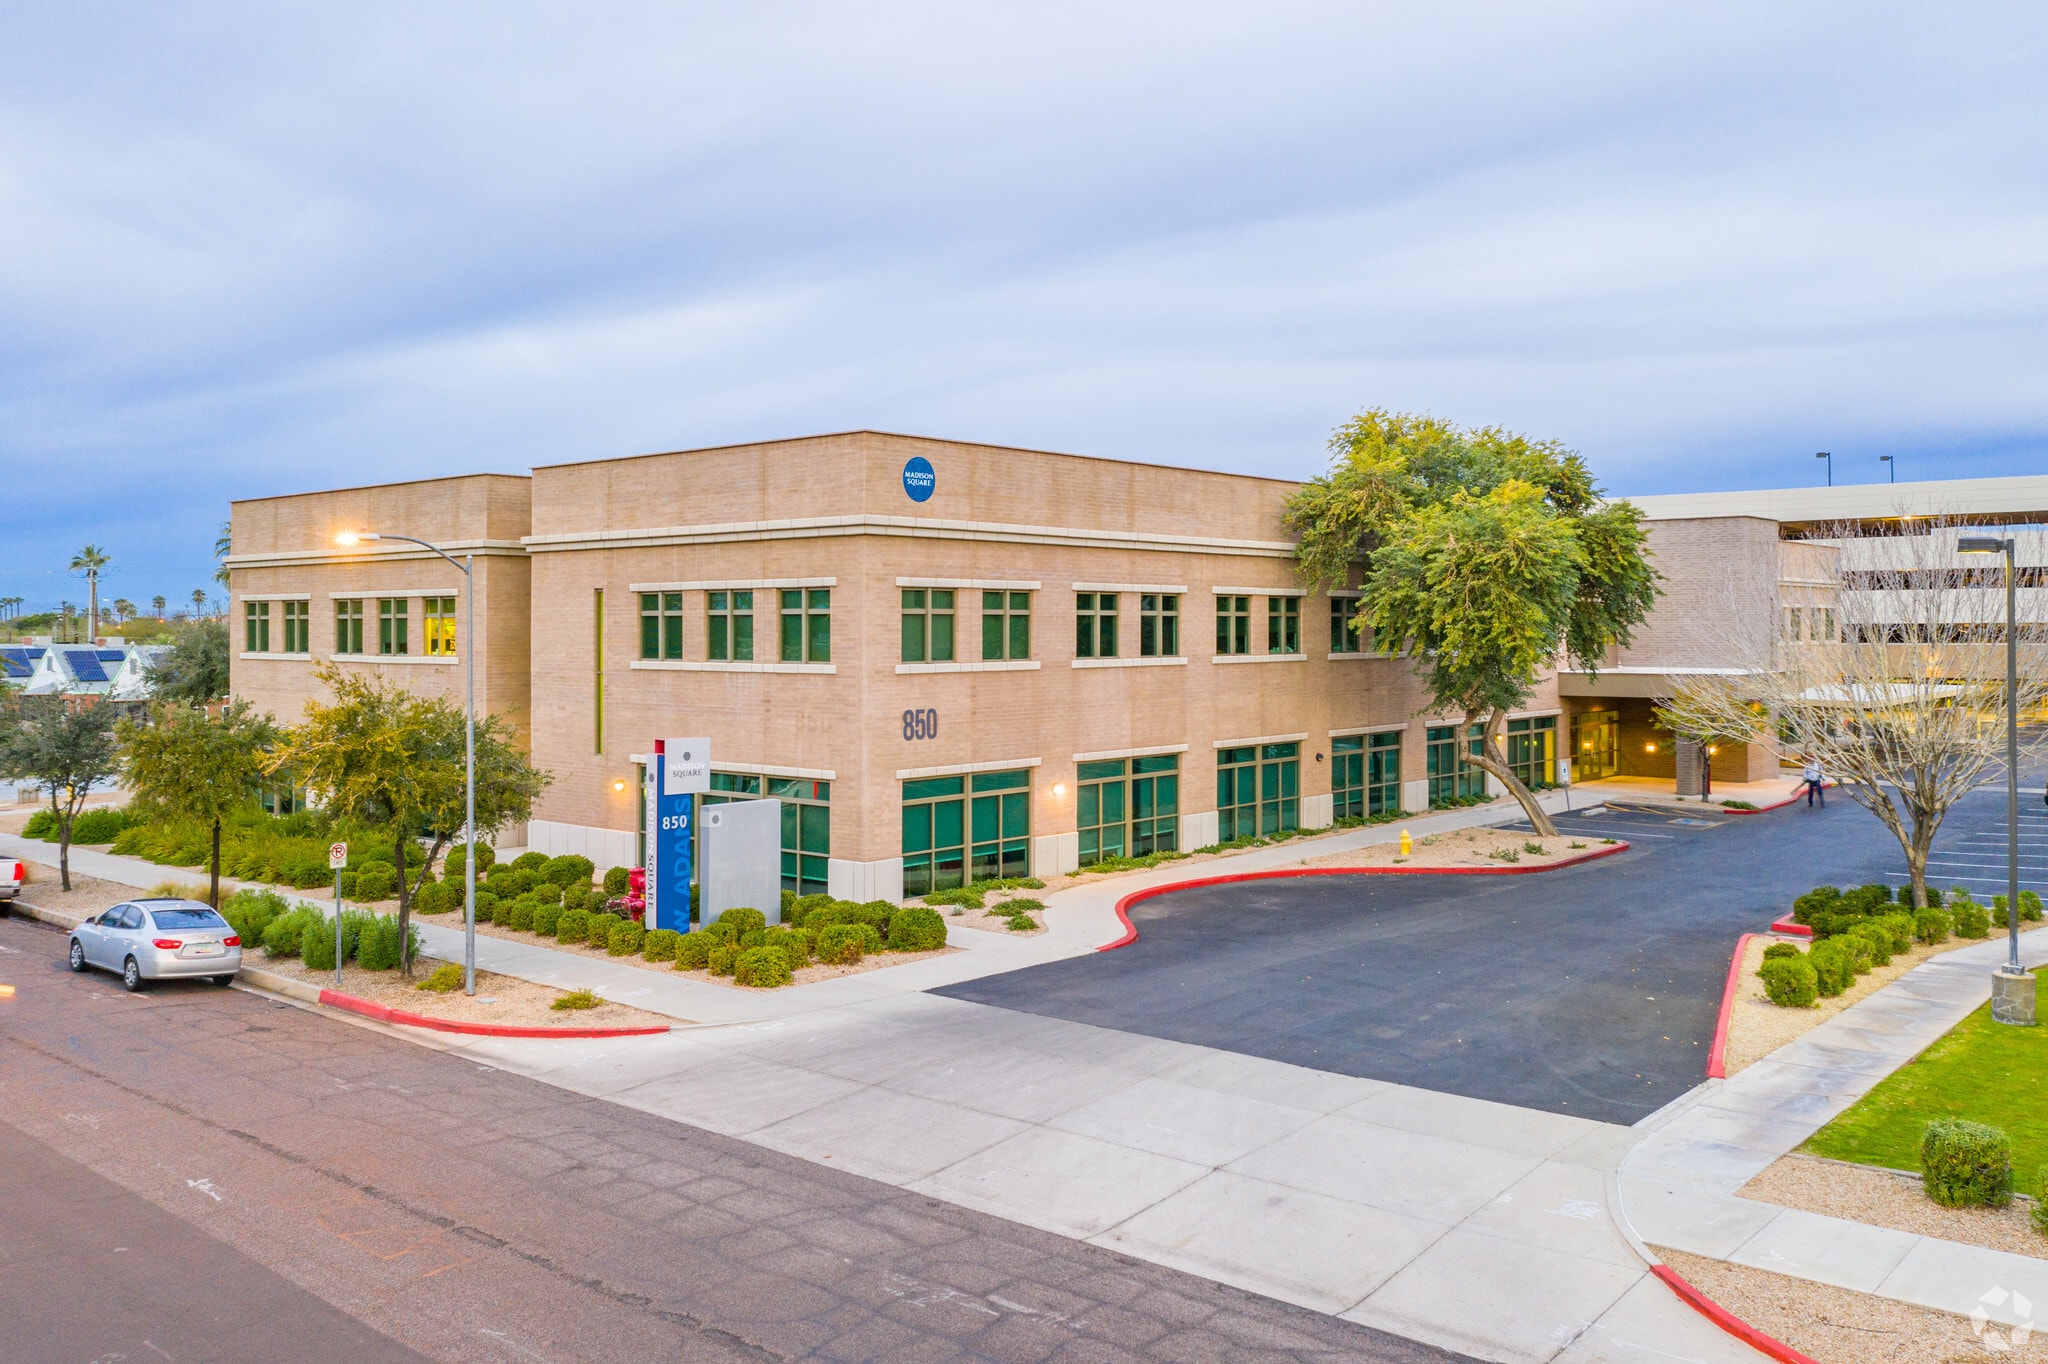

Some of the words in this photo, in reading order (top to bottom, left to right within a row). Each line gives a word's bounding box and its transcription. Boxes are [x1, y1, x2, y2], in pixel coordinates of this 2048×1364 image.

[905, 471, 934, 479] MADISON
[907, 478, 931, 486] SQUARE
[902, 708, 938, 741] 850
[670, 762, 705, 771] MADISON
[672, 769, 703, 778] SQUARE
[662, 814, 688, 830] 850
